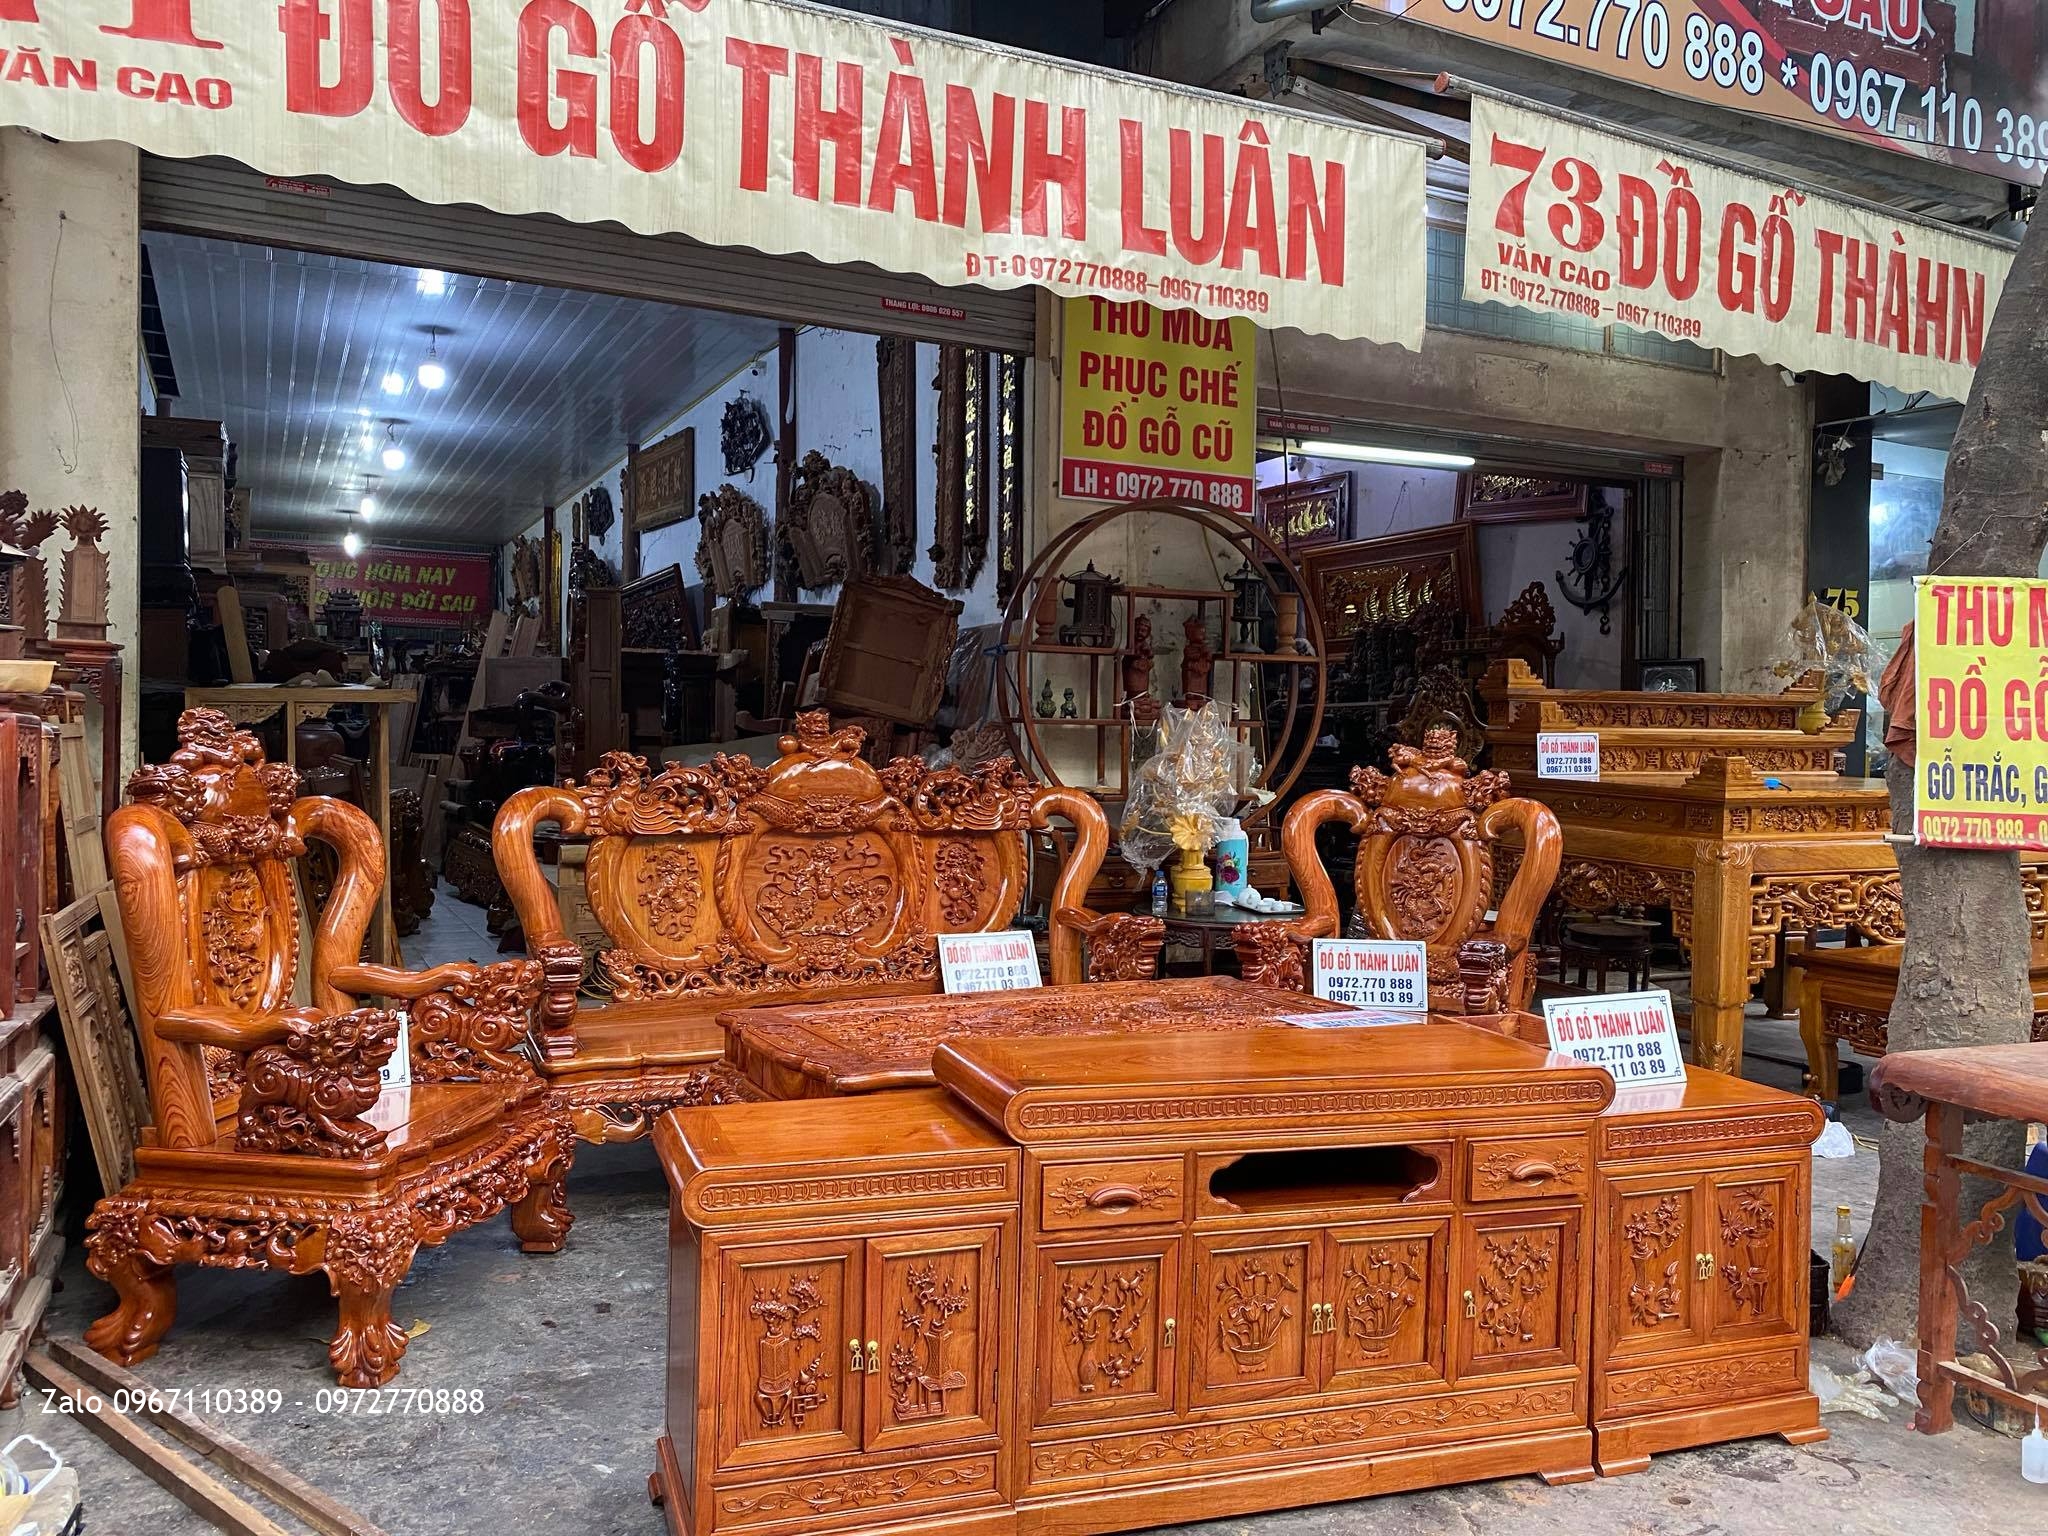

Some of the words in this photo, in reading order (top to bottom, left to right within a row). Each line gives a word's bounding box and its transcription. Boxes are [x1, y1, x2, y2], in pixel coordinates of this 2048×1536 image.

[0, 46, 97, 91] ĂN
[116, 66, 233, 110] CAO
[1684, 12, 1764, 95] 888
[1810, 52, 1982, 154] 0967.110
[517, 0, 710, 173] GỖ
[726, 37, 1086, 241] THÀNH
[1119, 120, 1345, 286] LUÂN
[1490, 131, 1605, 252] 73
[1616, 159, 1702, 300] ĐỒ
[1718, 188, 1806, 323] GỖ
[1498, 241, 1552, 277] VĂN
[1559, 260, 1611, 291] CAO
[1088, 295, 1151, 338] THU
[1162, 310, 1233, 352] MUA
[1080, 351, 1167, 403] PHỤC
[1179, 361, 1242, 408] CHẾ
[1083, 401, 1127, 450] ĐỒ
[1139, 406, 1181, 456] GỖ
[1193, 420, 1233, 462] CŨ
[1074, 467, 1098, 495] LH
[1209, 482, 1243, 509] 888
[416, 566, 457, 586] NAY
[440, 595, 478, 612] SAU
[1826, 587, 1860, 618] 75
[1932, 585, 2014, 647] THU
[1928, 656, 1987, 740] ĐỒ
[1546, 757, 1578, 765] 0972.770
[1546, 765, 1572, 773] 0967.11
[1574, 765, 1582, 773] 03
[1584, 765, 1592, 773] 89
[1928, 747, 1955, 801] GỖ
[1962, 751, 2027, 808] TRẮC,
[1923, 815, 1961, 843] 0972
[1963, 817, 1993, 845] 770
[1995, 818, 2025, 846] 888
[1005, 939, 1030, 960] LUÂN
[1354, 949, 1389, 972] THÀNH
[1391, 950, 1419, 972] LUÂN
[1001, 979, 1014, 990] 03
[1328, 976, 1386, 989] 0972.770
[1390, 978, 1413, 990] 888
[1329, 990, 1375, 1002] 0967.11
[1380, 992, 1394, 1003] 03
[1399, 992, 1413, 1003] 89
[1556, 1009, 1574, 1042] ĐỒ
[1576, 1007, 1593, 1040] GỖ
[1593, 1009, 1633, 1038] THÀNH
[1633, 1005, 1666, 1035] LUÂN
[1573, 1043, 1633, 1062] 0972.770
[1637, 1041, 1662, 1057] 888
[1630, 1060, 1647, 1076] 03
[1650, 1058, 1666, 1074] 89
